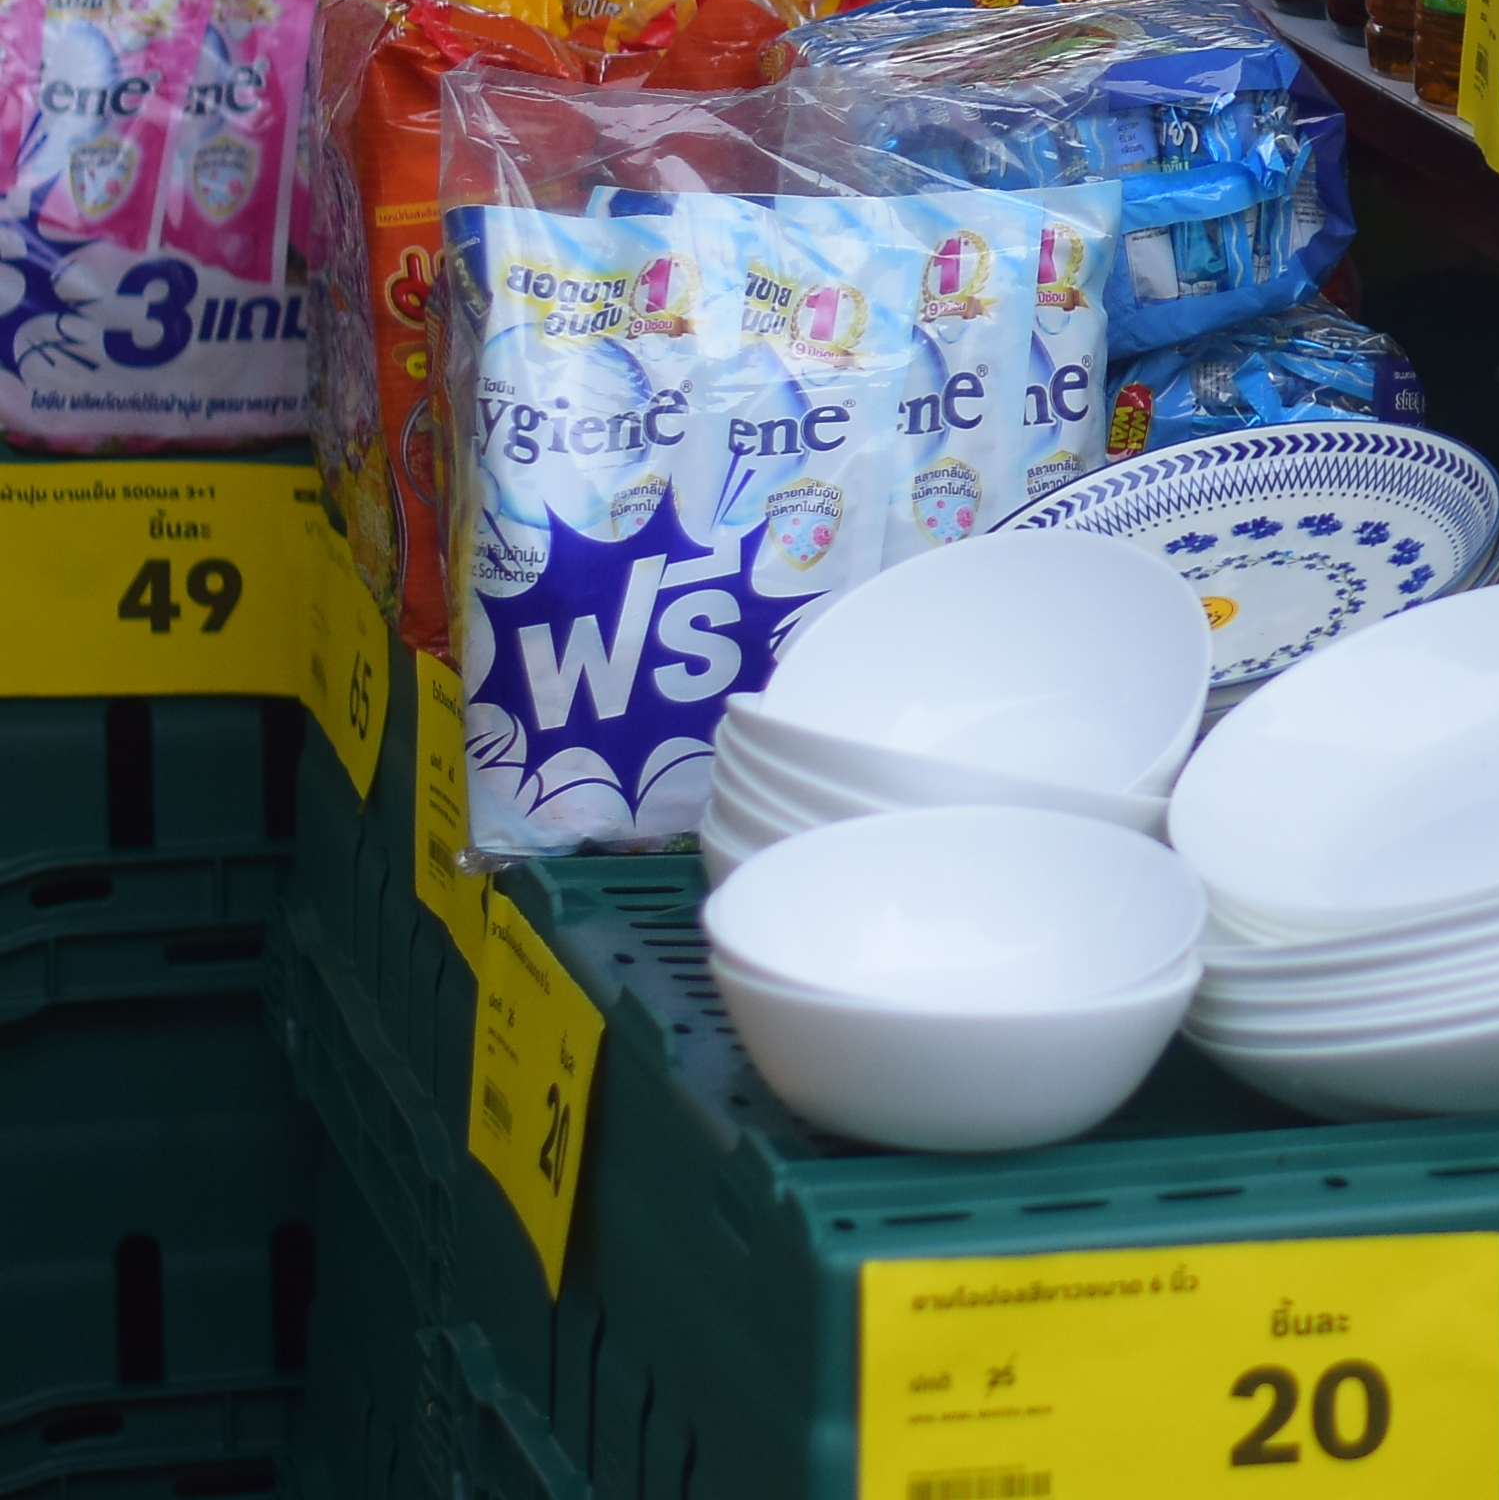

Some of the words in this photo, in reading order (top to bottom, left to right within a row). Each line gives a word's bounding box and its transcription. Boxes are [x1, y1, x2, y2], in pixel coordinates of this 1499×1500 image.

[641, 257, 673, 313] 1
[933, 237, 963, 295] 1
[103, 259, 199, 368] 3
[633, 320, 643, 333] 9
[806, 286, 840, 342] 1
[929, 302, 938, 317] 9
[795, 342, 805, 356] 9
[477, 388, 690, 465] ygiene
[767, 483, 840, 504] สลายกลิ่นอับ
[913, 463, 978, 485] สลายกลิ่นอับ
[149, 508, 212, 541] ชิ้นละ
[117, 556, 243, 634] 49
[518, 535, 743, 731] ฟรี
[348, 649, 374, 743] 65
[539, 1082, 571, 1199] 20
[1271, 1299, 1350, 1339] ชิ้นละ
[1229, 1358, 1391, 1468] 20
